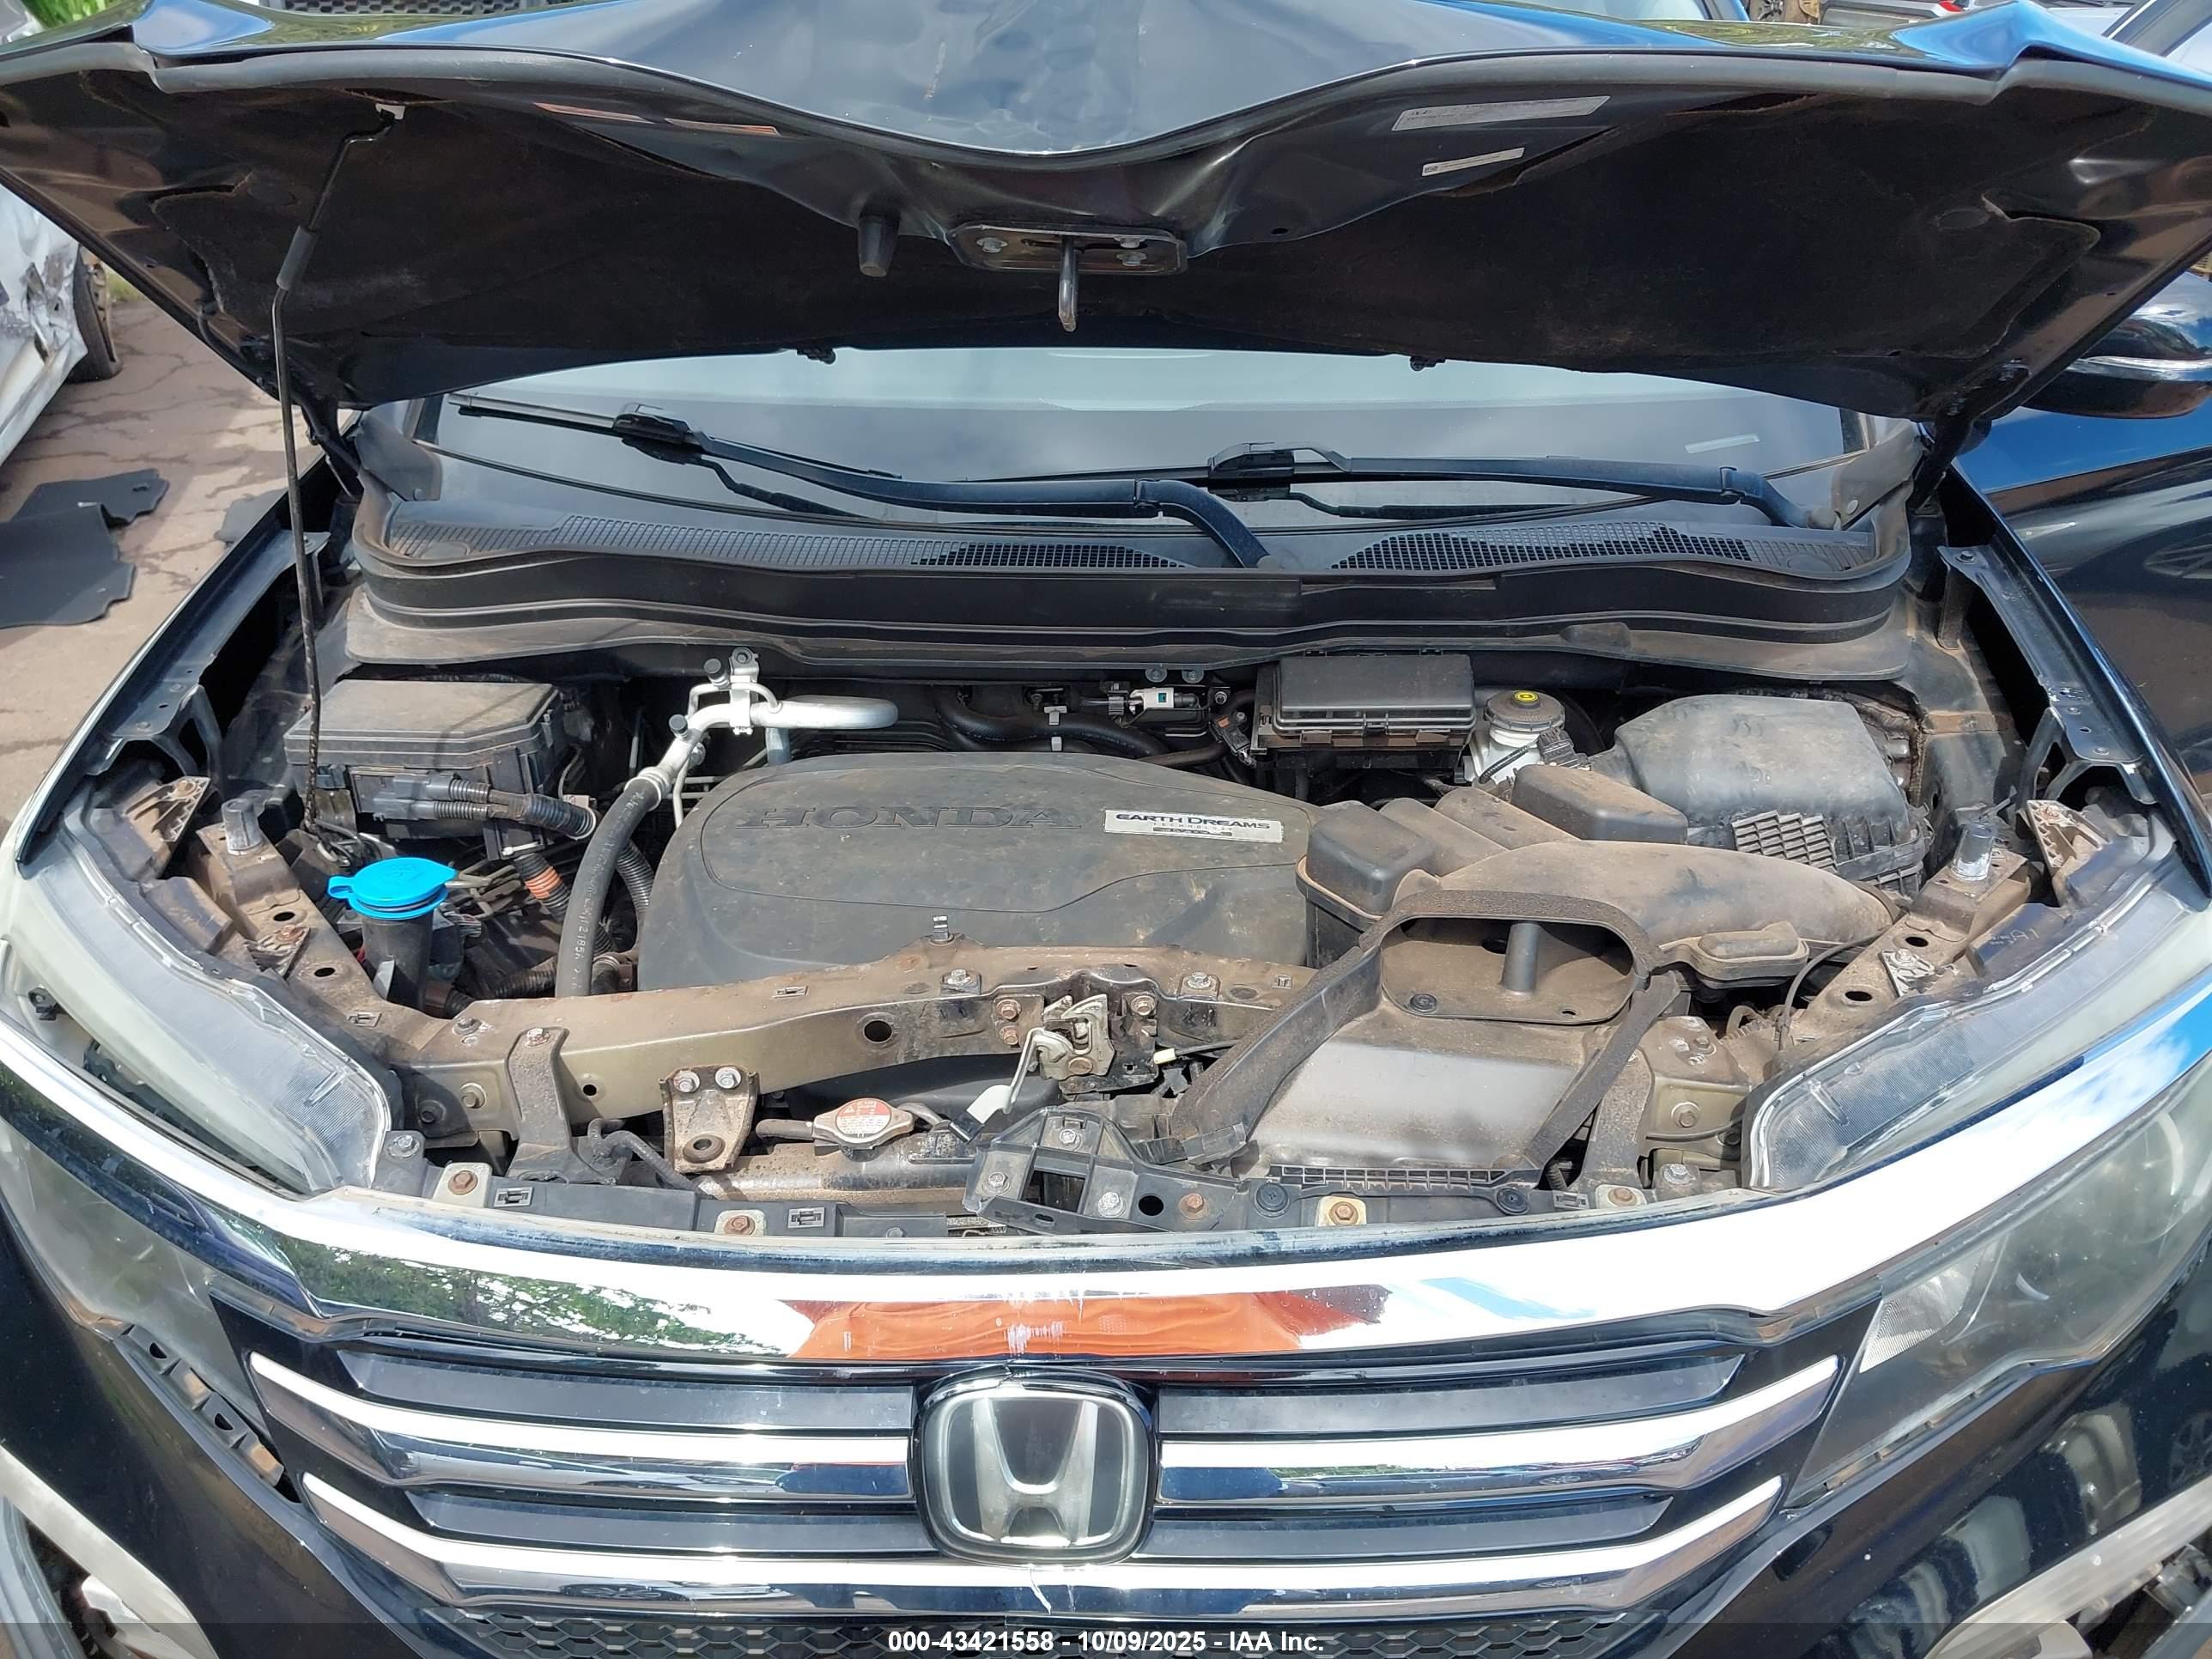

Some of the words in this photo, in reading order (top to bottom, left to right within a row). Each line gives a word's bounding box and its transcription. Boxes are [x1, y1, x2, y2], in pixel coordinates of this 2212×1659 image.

[736, 805, 1083, 830] HONDA
[1115, 813, 1183, 823] EARTH
[1187, 816, 1271, 830] DREAMS
